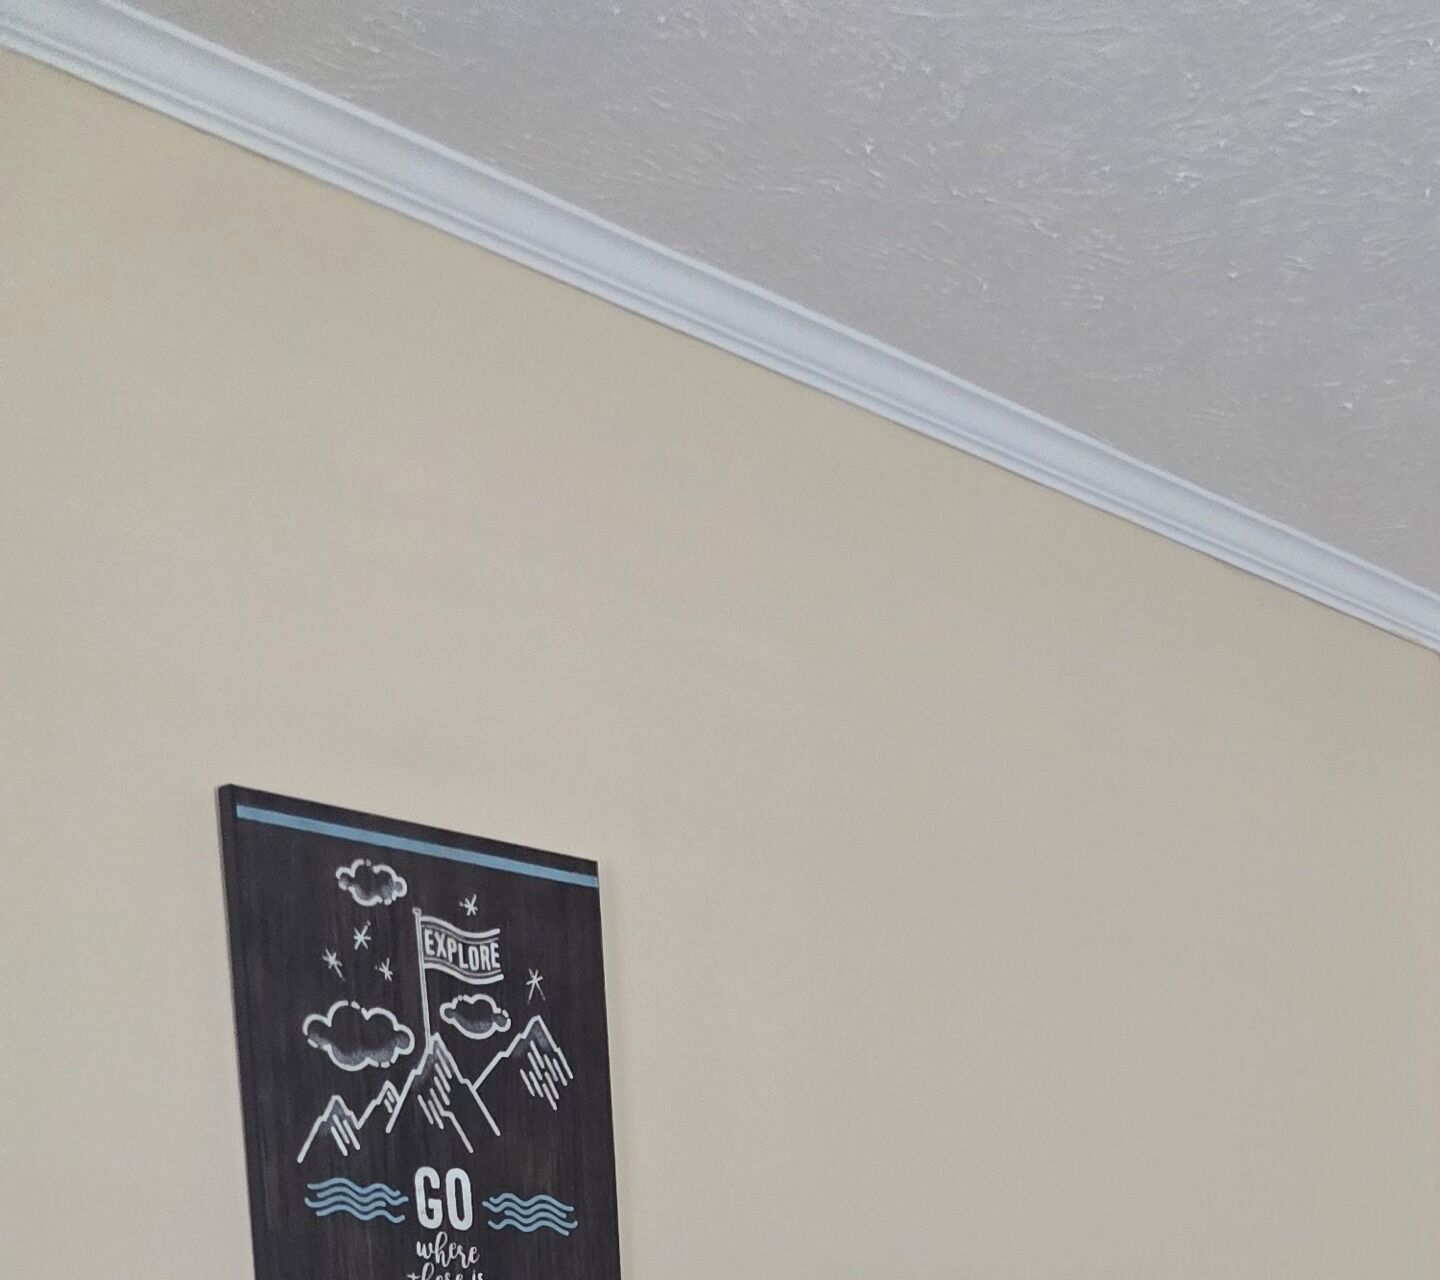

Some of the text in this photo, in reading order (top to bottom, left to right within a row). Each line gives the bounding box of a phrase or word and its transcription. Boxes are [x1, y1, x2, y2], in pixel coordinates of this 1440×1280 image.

[423, 928, 502, 972] EXPLORE
[414, 1165, 474, 1231] GO
[415, 1229, 481, 1268] where
